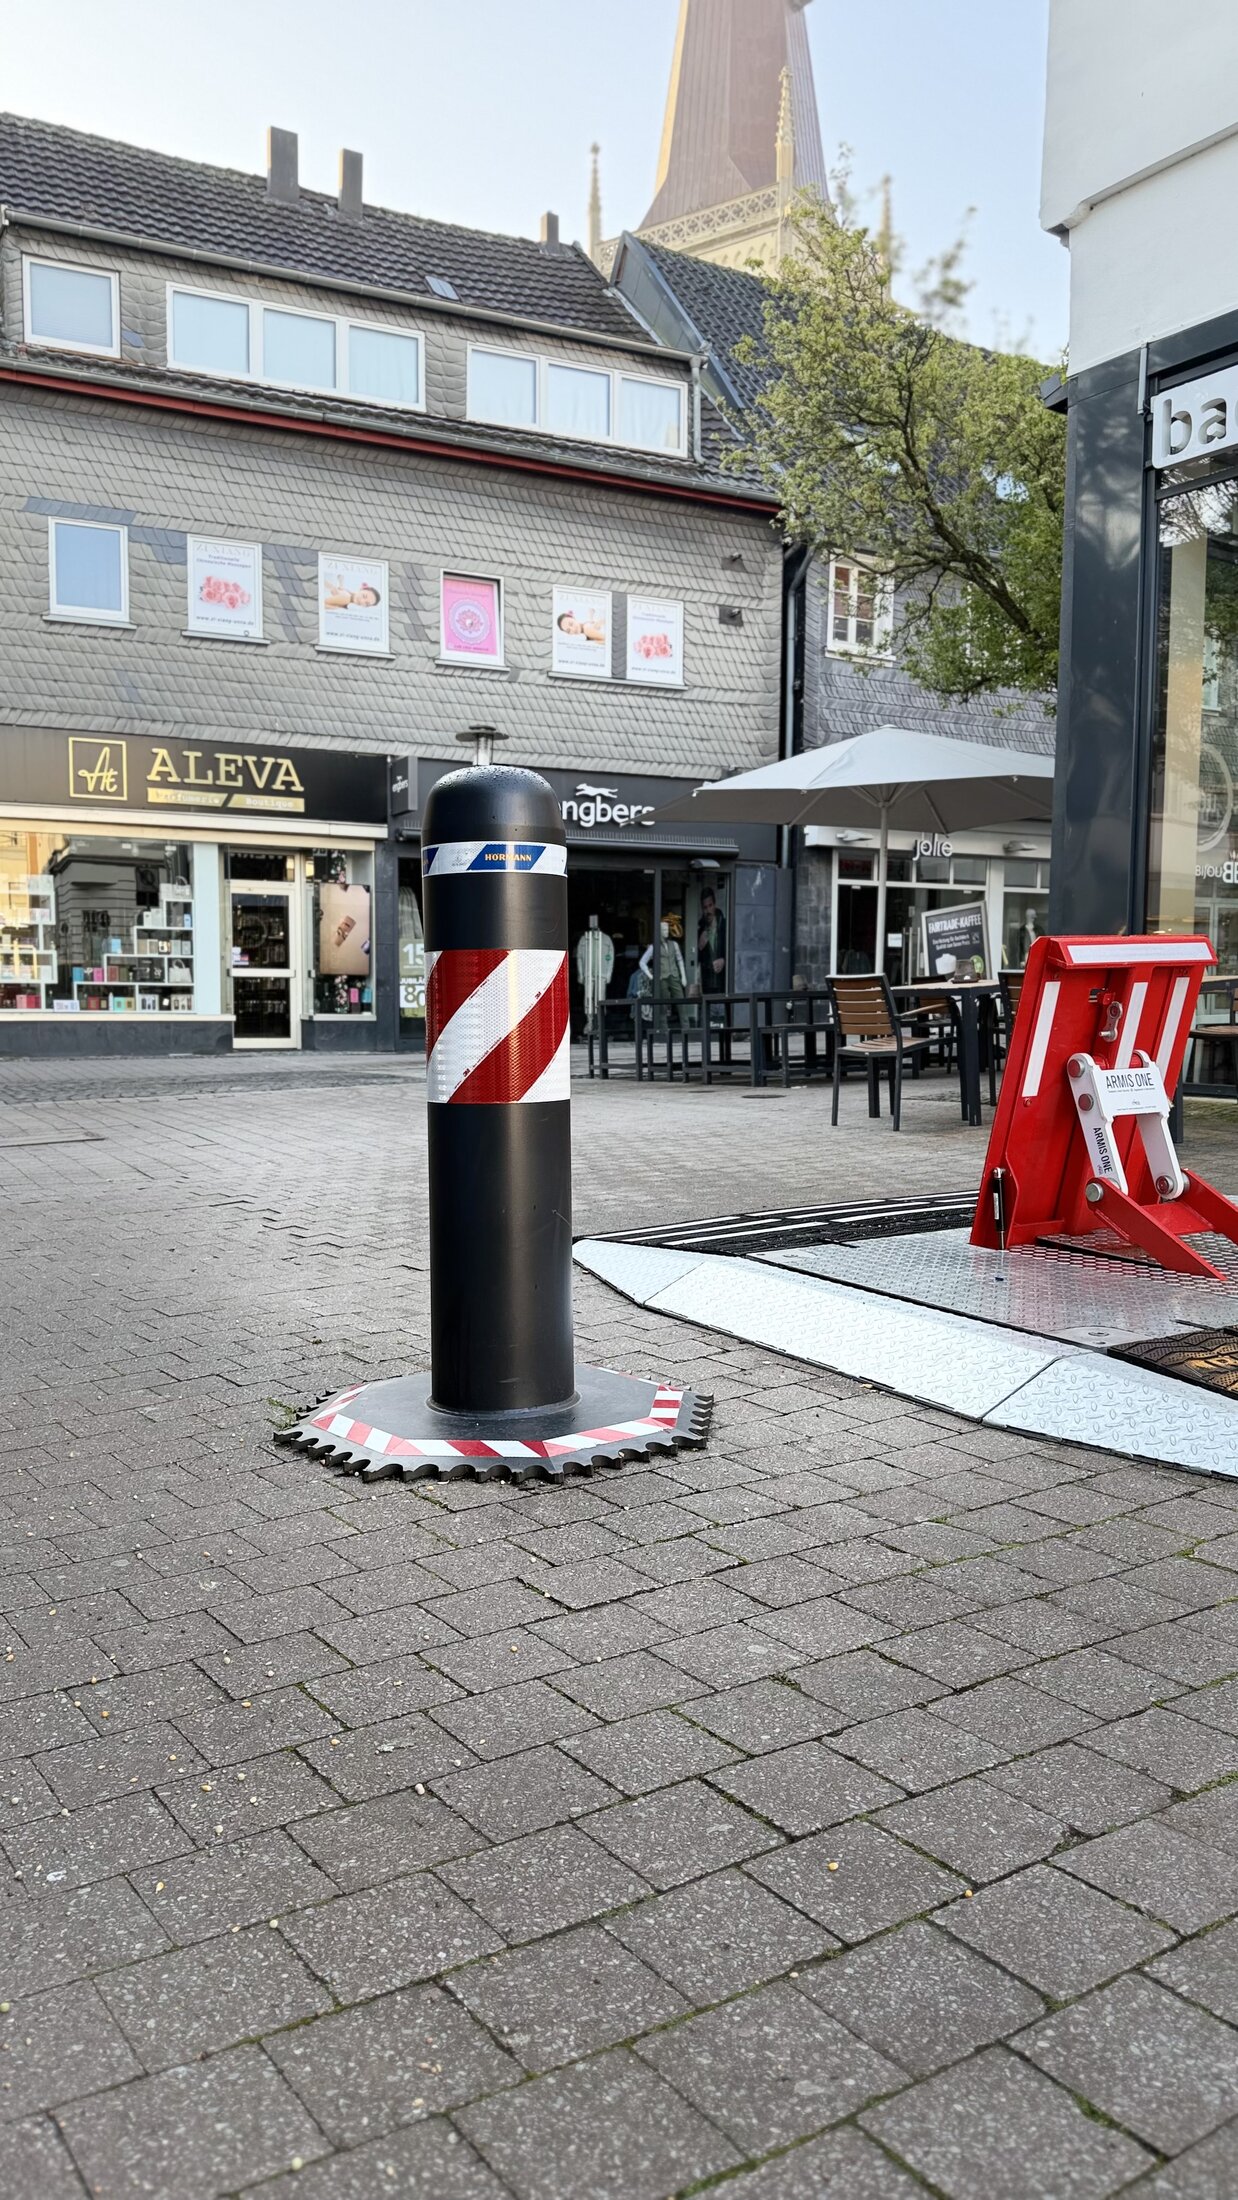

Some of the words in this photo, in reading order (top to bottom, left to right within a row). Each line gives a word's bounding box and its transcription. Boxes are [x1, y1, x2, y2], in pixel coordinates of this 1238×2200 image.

[1161, 398, 1238, 458] ba
[146, 747, 305, 792] ALEVA
[245, 796, 294, 809] Boutique
[558, 795, 655, 828] ngbers
[928, 914, 982, 934] FAIRTRADE-KAFFEE
[1105, 1073, 1135, 1089] ARMIS
[1135, 1072, 1154, 1087] ONE
[1093, 1127, 1108, 1155] ARMIS
[1100, 1155, 1113, 1174] ONE
